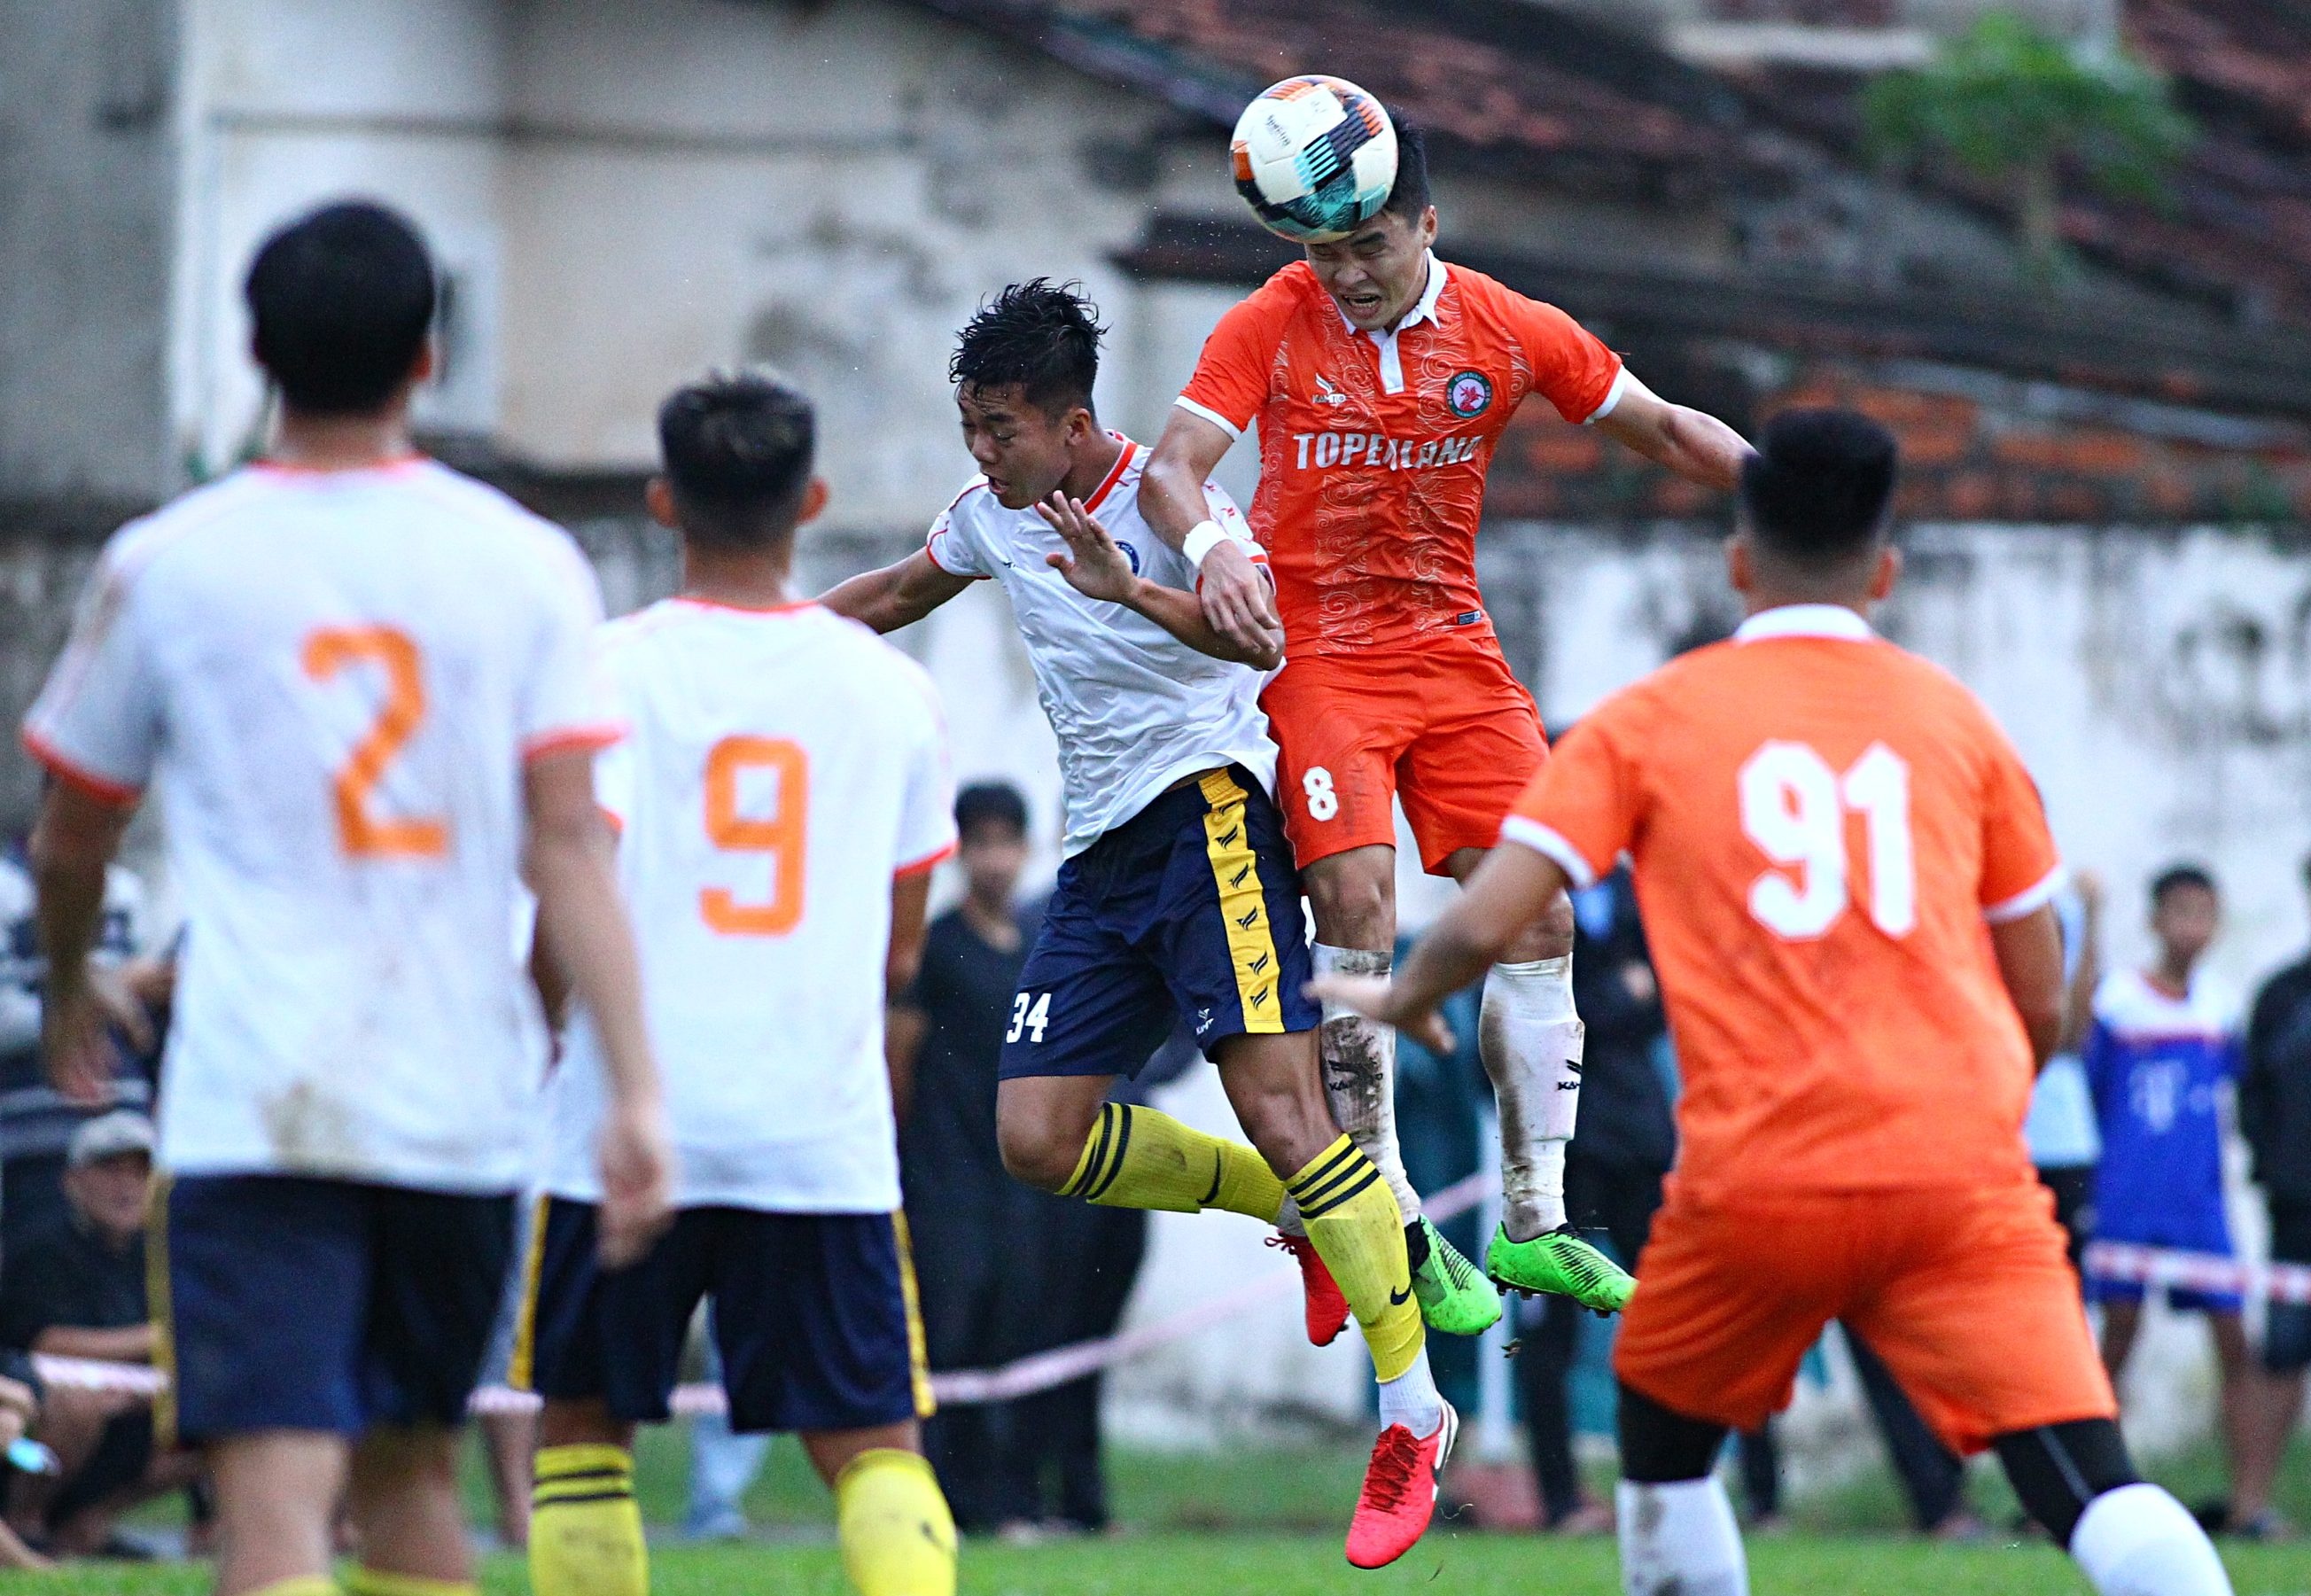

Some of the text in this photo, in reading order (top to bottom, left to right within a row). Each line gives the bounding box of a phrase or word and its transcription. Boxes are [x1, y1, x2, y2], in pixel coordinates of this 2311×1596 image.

[301, 626, 448, 860] 2
[701, 736, 808, 937] 9
[1302, 766, 1339, 821] 8
[1738, 739, 1917, 941] 91
[1005, 992, 1052, 1043] 34
